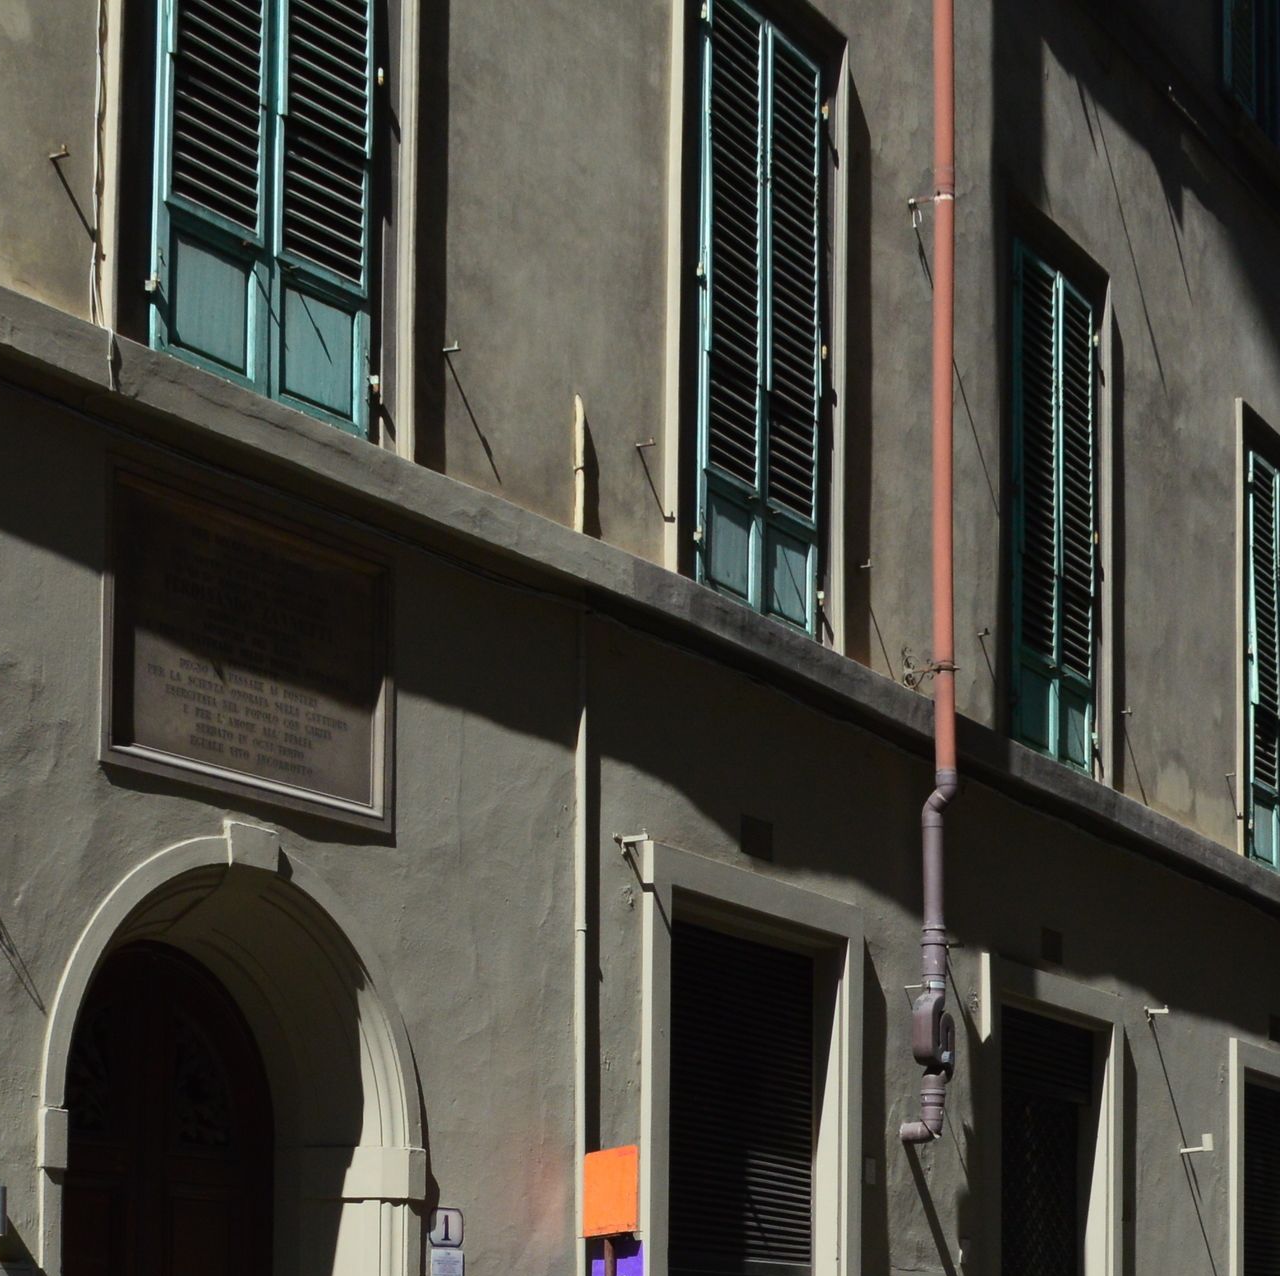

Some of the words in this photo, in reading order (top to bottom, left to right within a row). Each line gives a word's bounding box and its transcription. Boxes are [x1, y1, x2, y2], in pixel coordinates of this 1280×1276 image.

[169, 669, 181, 683] LA
[245, 705, 279, 726] POPOLO
[441, 1214, 451, 1241] 1
